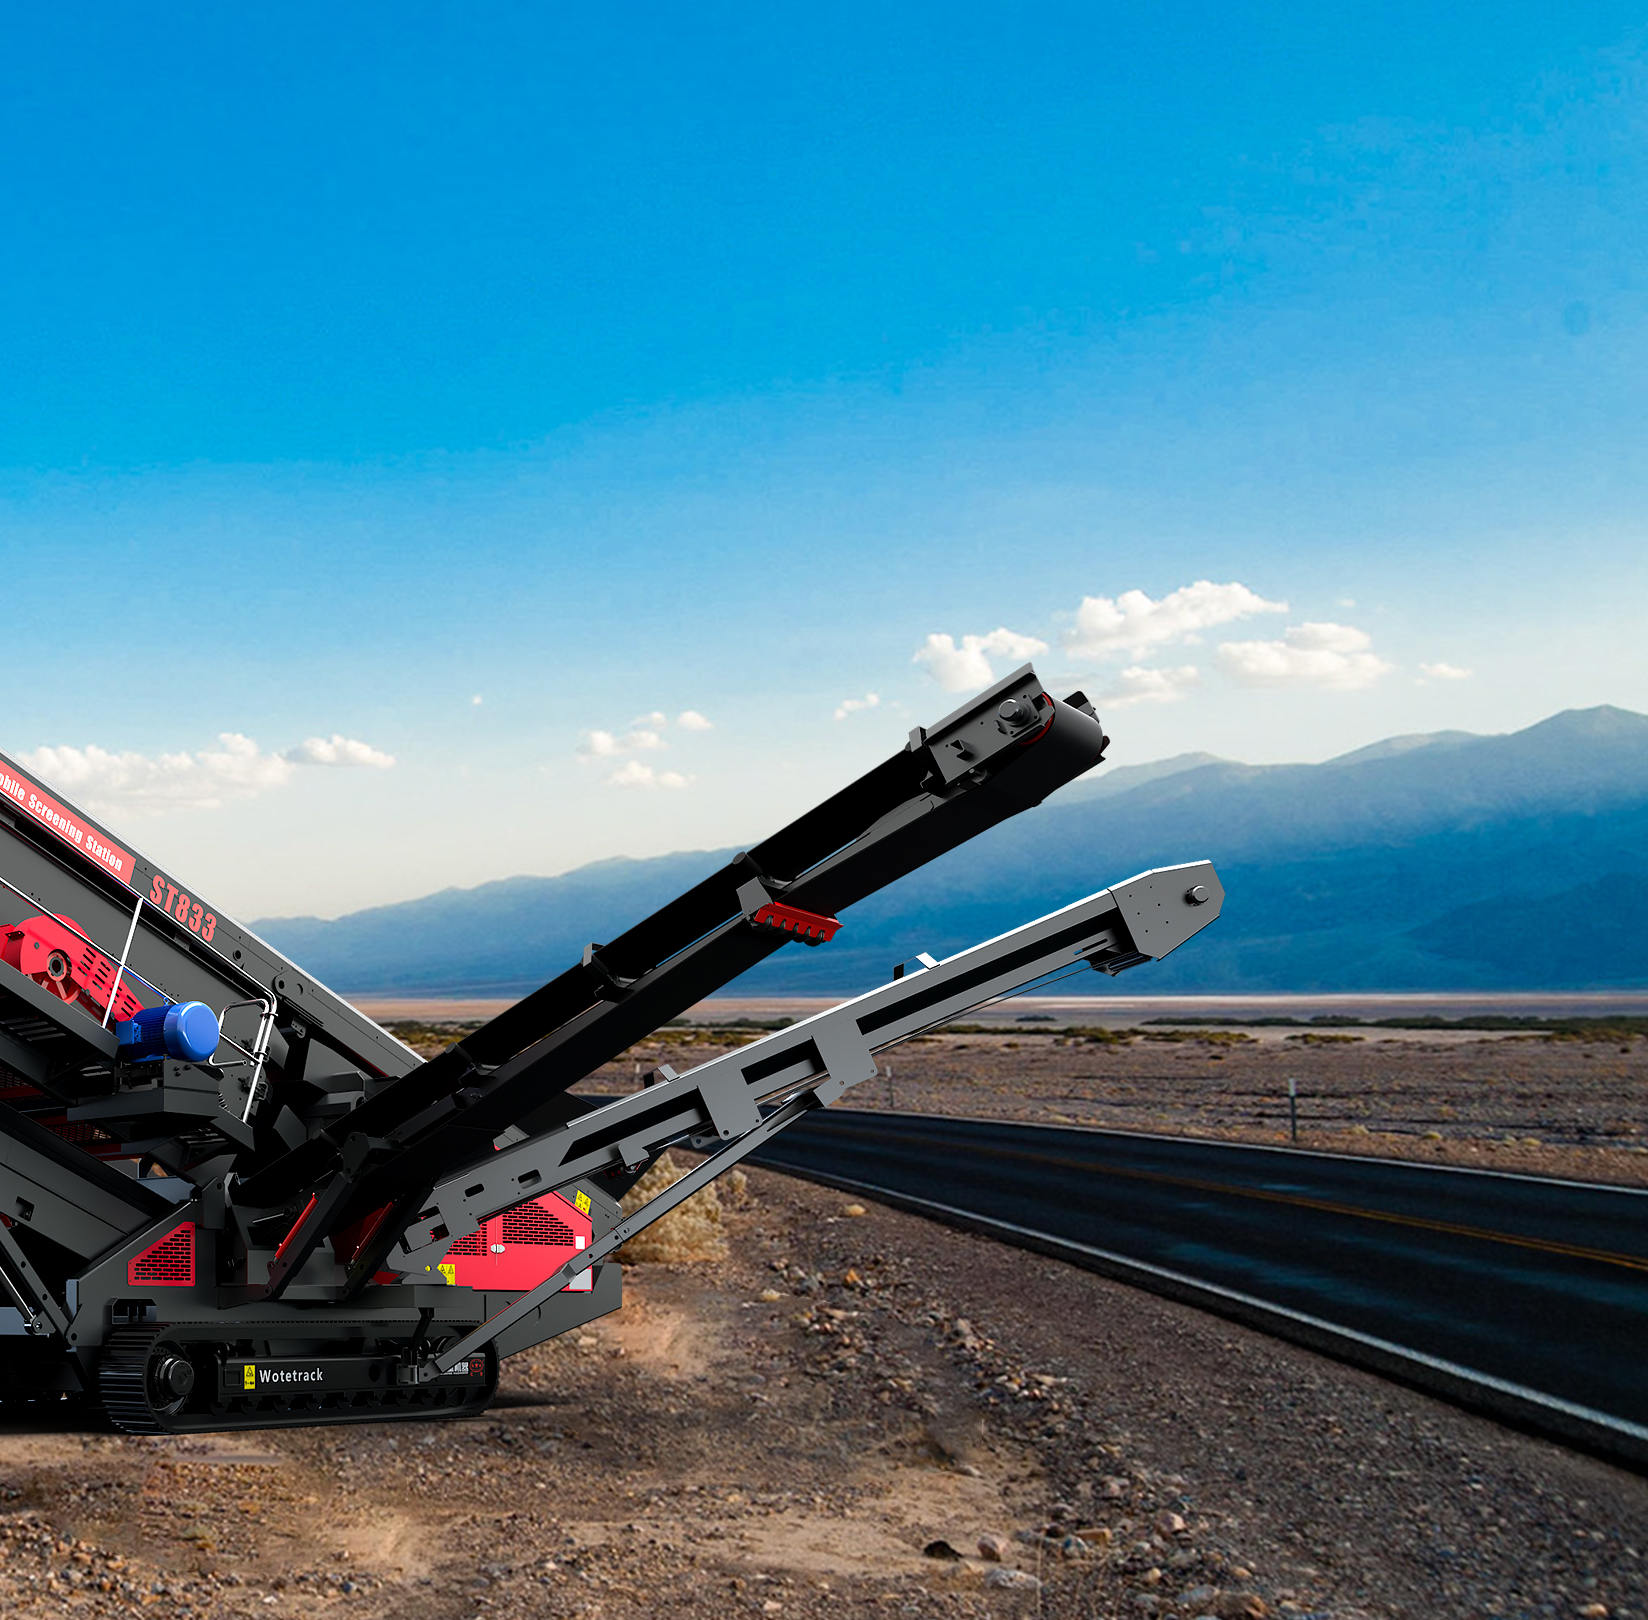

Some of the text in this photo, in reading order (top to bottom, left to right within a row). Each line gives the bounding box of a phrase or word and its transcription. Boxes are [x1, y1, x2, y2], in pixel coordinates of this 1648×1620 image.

[28, 793, 83, 844] Screening
[85, 835, 123, 872] Station
[149, 874, 217, 942] ST833
[259, 1367, 324, 1383] Wotetrack
